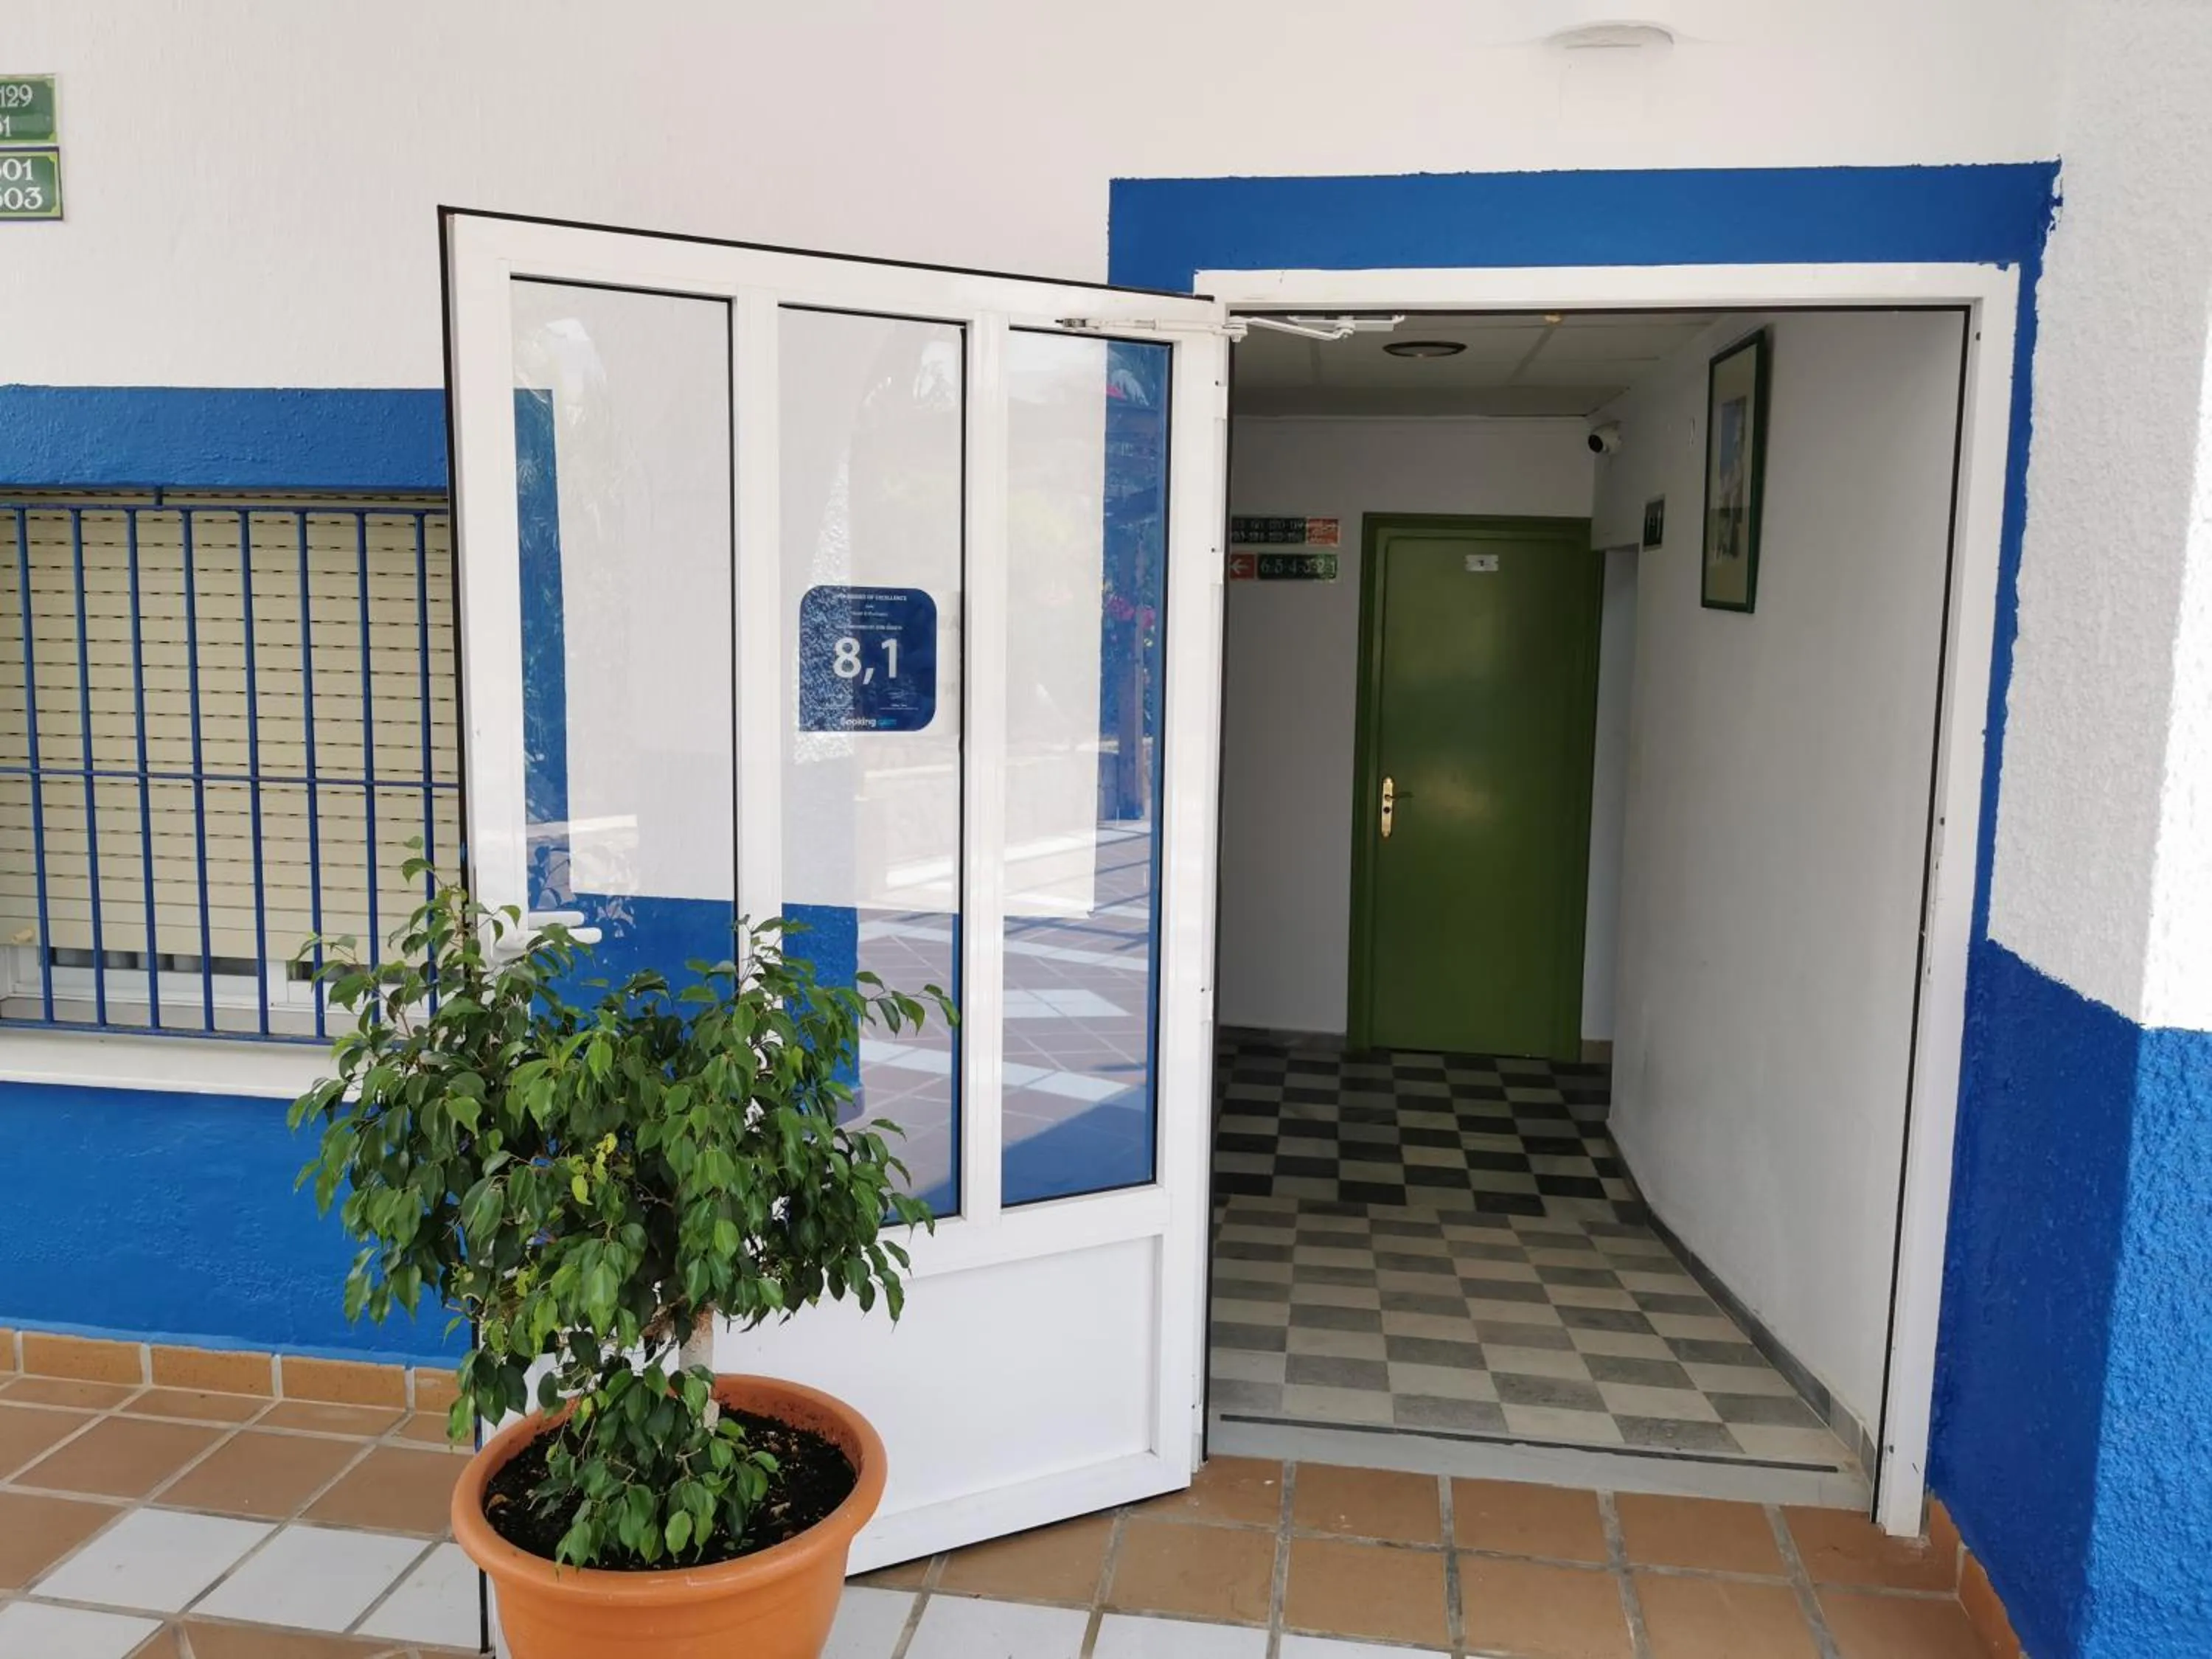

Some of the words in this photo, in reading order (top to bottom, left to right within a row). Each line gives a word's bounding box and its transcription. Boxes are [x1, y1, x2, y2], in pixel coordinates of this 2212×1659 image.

[0, 158, 34, 181] 01
[0, 187, 44, 210] 03
[832, 636, 897, 685] 8,1
